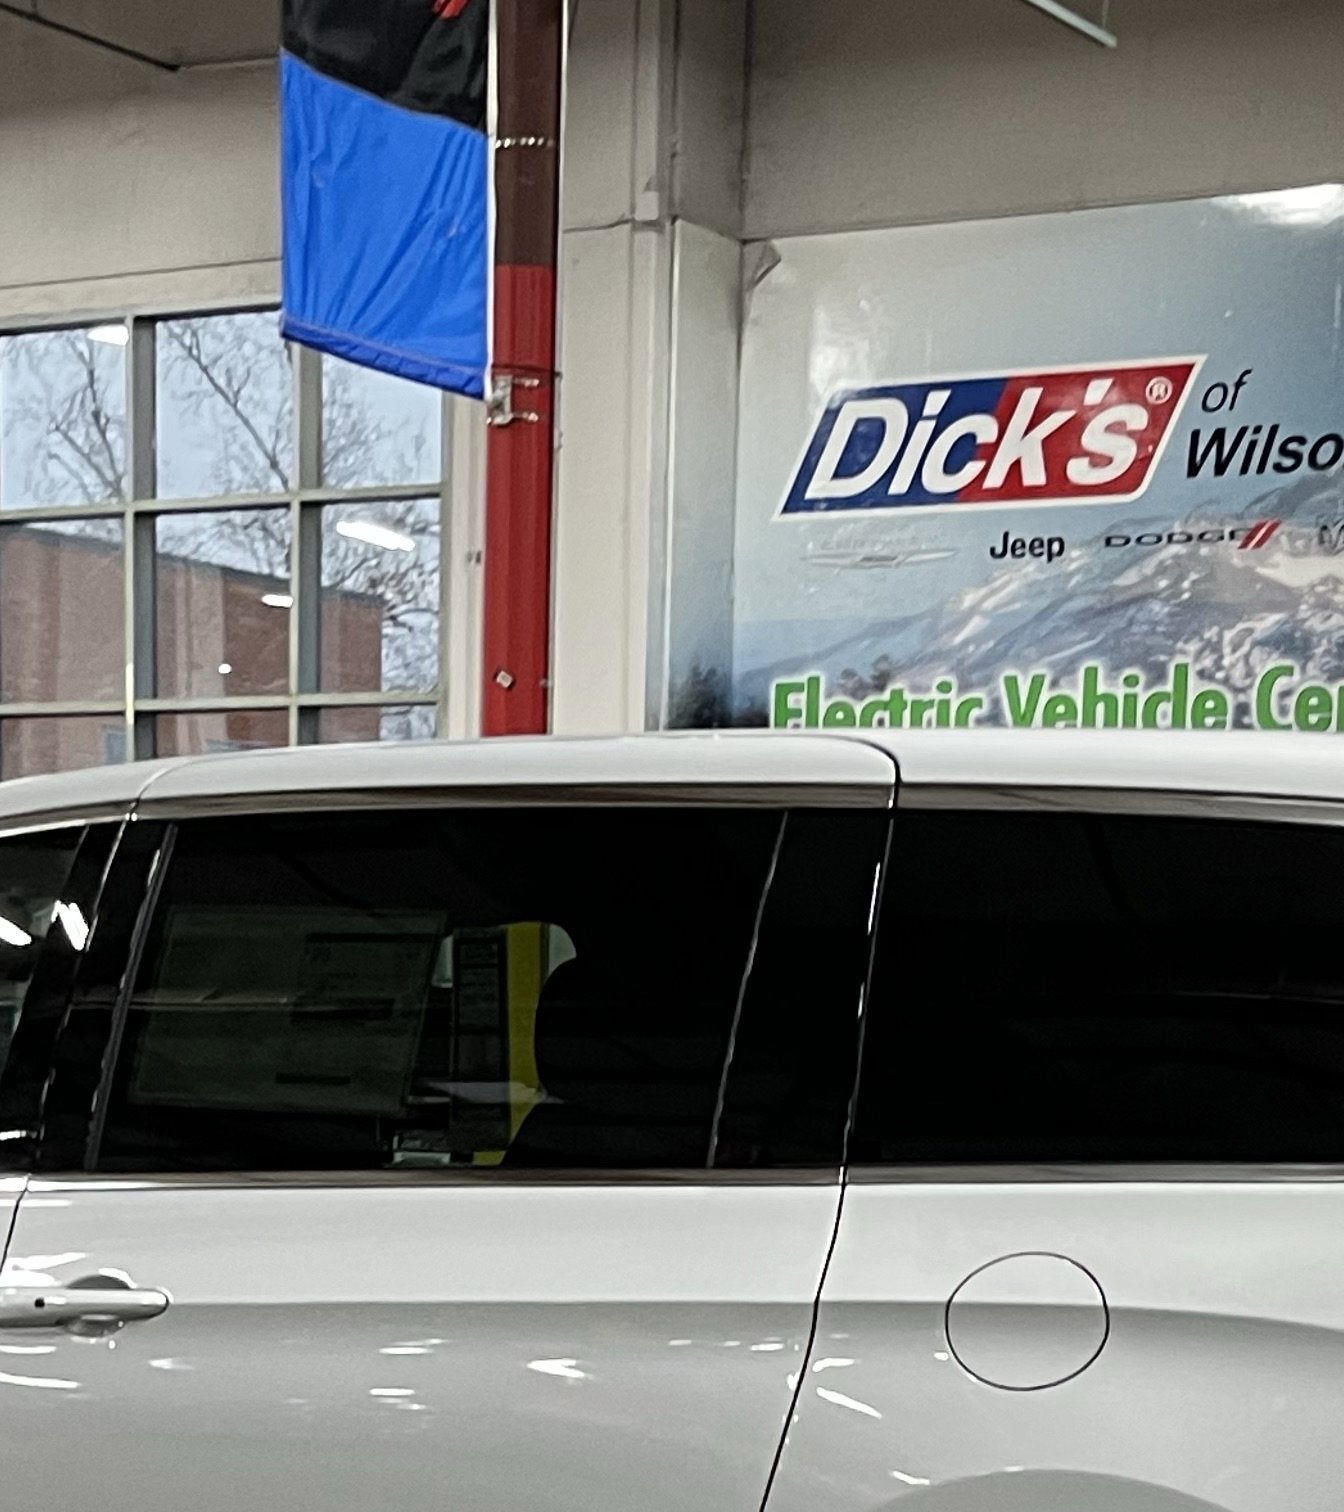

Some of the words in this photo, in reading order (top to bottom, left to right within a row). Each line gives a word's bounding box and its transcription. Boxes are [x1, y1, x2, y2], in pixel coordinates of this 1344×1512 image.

[1201, 369, 1253, 413] of
[989, 530, 1065, 563] Jeep
[774, 675, 983, 729] Electric
[1003, 662, 1228, 730] Vehicle
